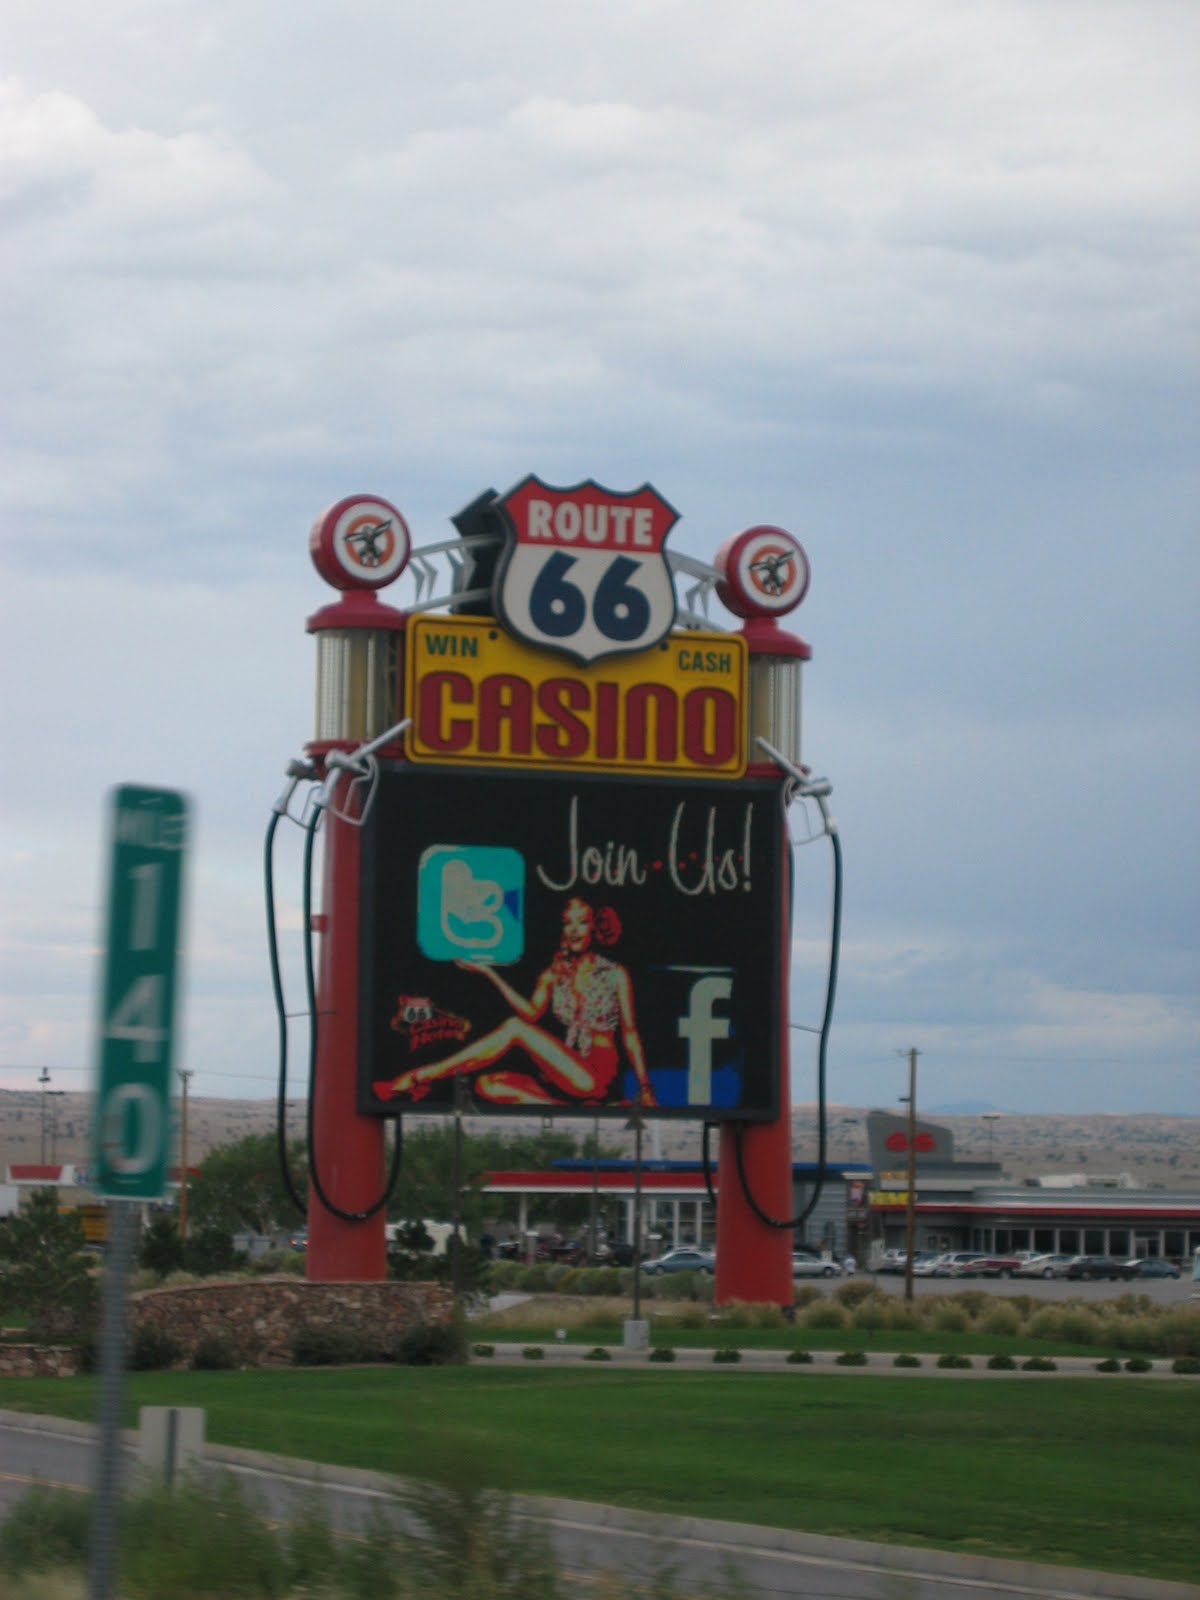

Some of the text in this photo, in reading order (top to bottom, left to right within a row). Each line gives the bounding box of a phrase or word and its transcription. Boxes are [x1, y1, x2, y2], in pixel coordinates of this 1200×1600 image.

[527, 499, 654, 546] ROUTE
[529, 549, 652, 642] 66
[425, 633, 478, 658] WIN
[677, 650, 732, 674] CASH
[417, 669, 738, 768] CASINO
[536, 795, 753, 896] Join Us!
